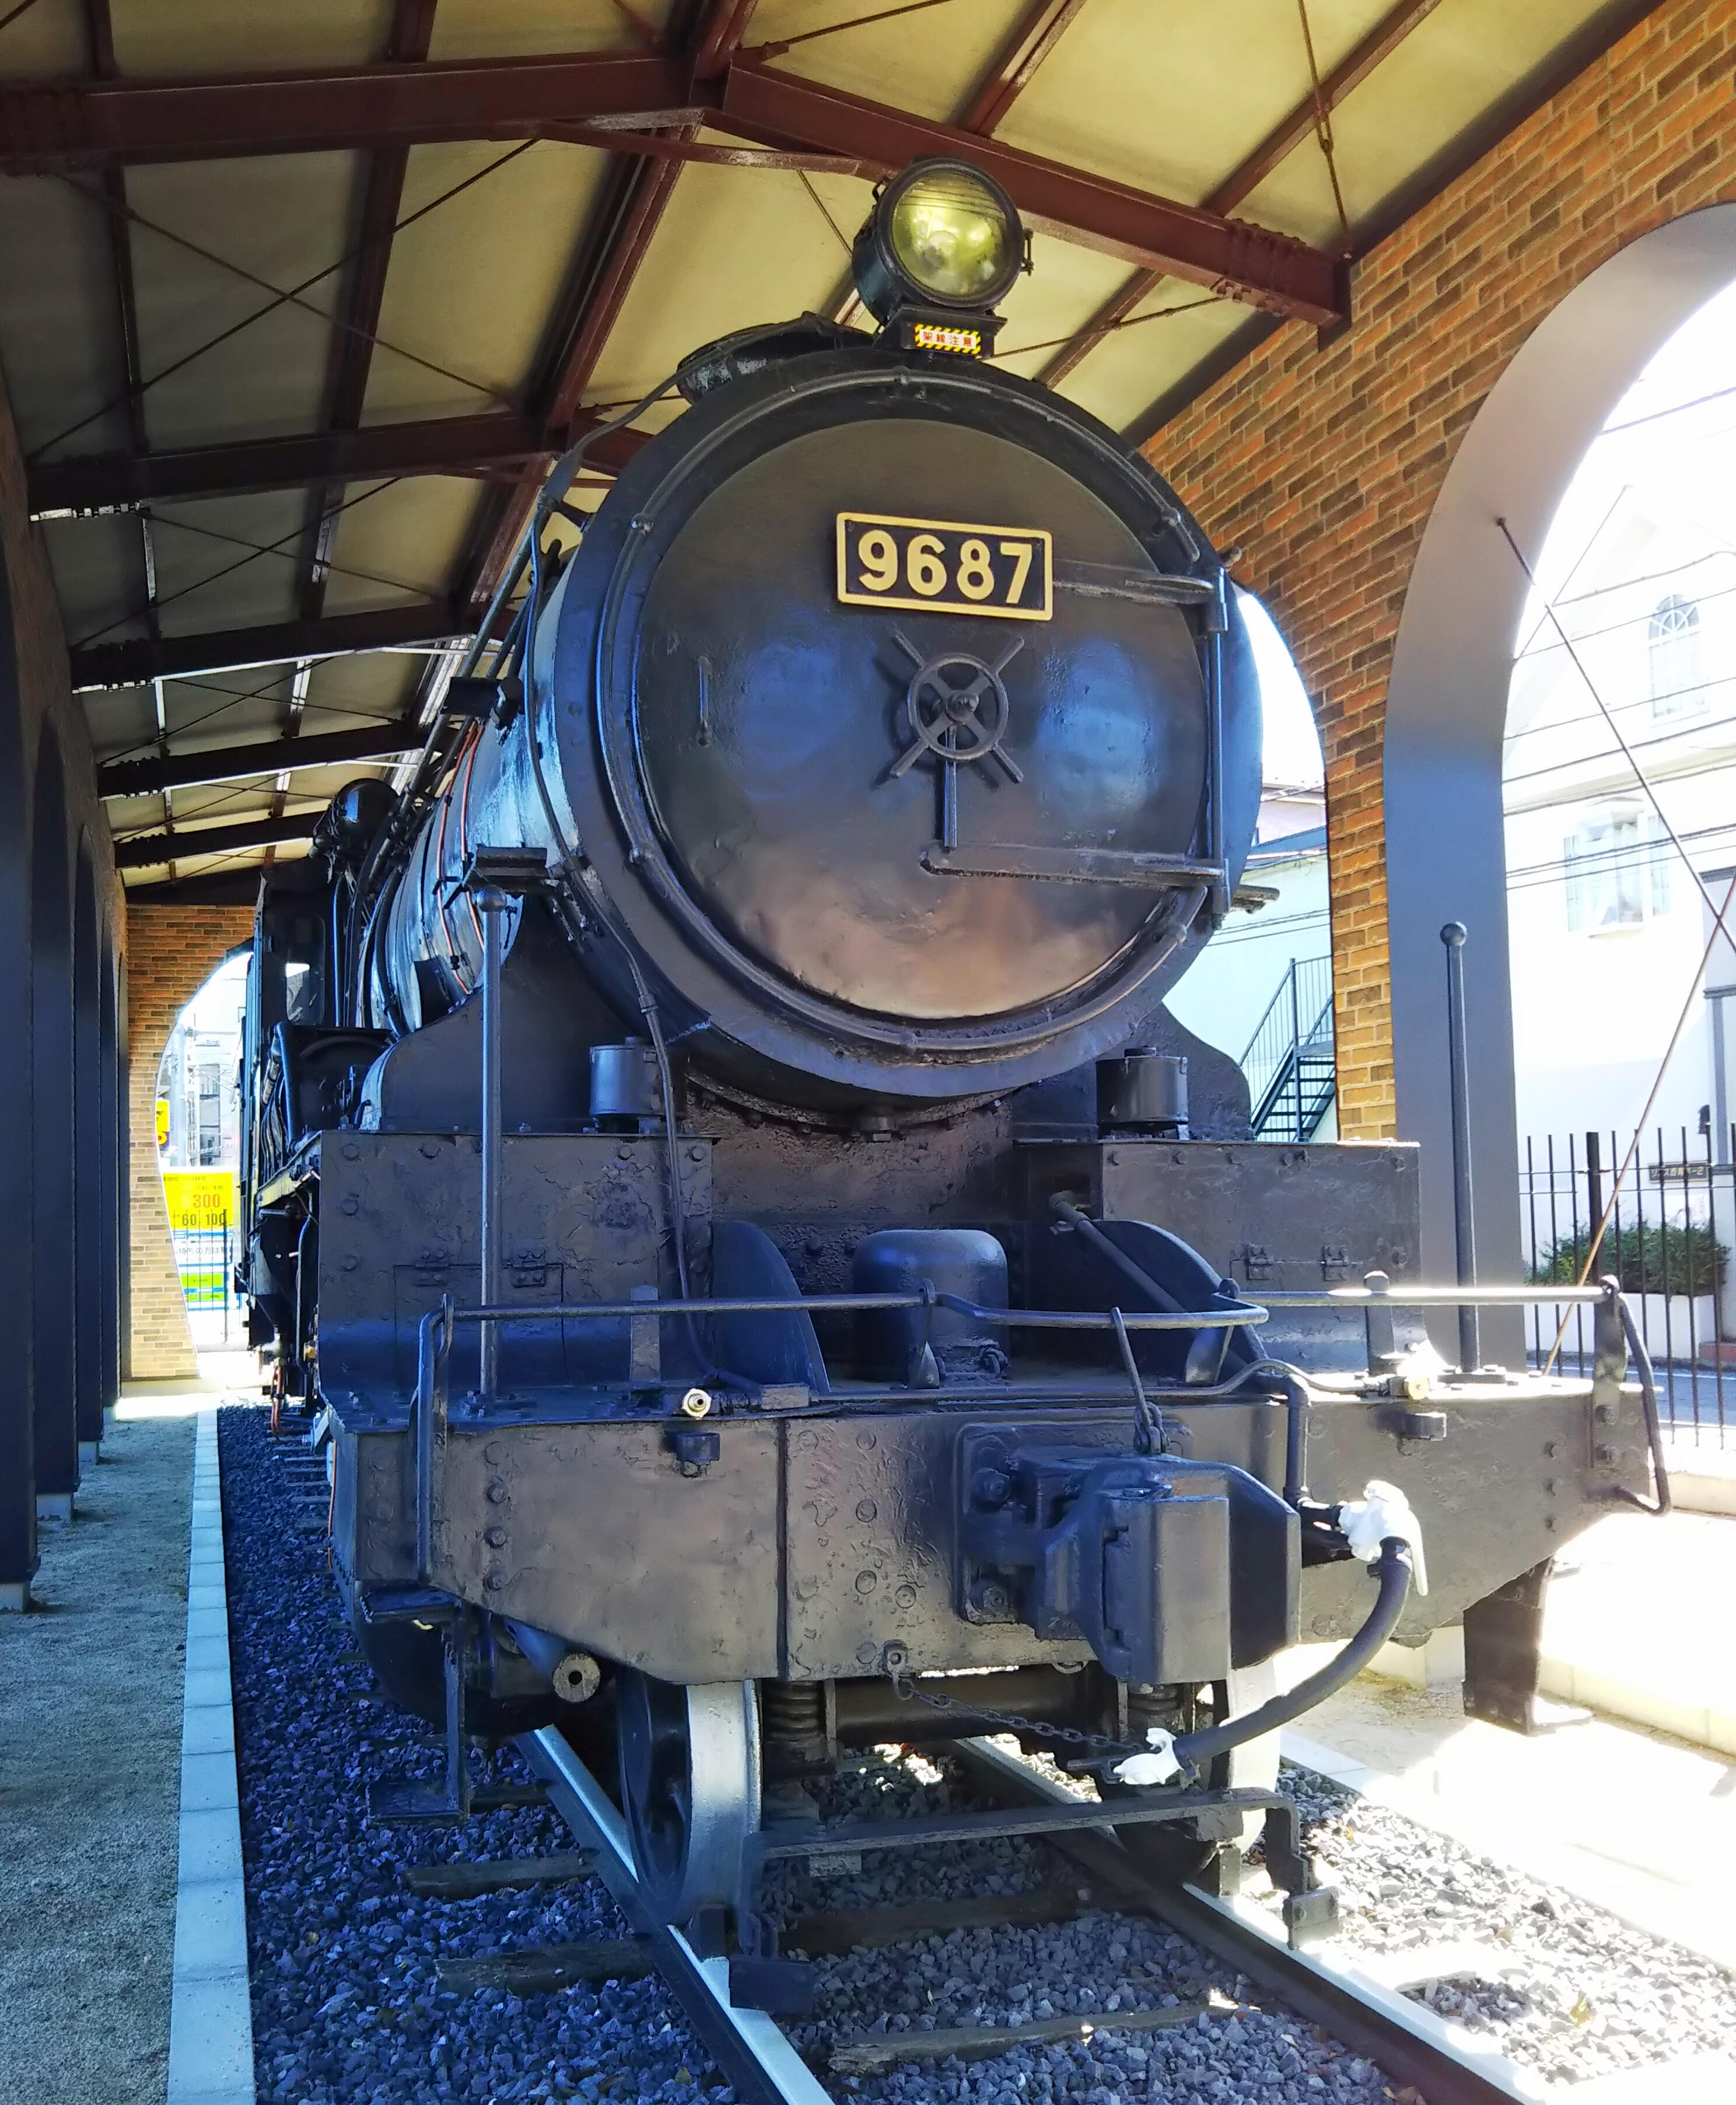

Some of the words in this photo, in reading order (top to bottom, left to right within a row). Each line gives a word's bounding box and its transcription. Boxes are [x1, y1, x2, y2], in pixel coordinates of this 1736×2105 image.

[922, 331, 972, 347] 架線注意
[858, 529, 1032, 604] 9687
[193, 1194, 220, 1208] 300
[182, 1214, 197, 1226] 60
